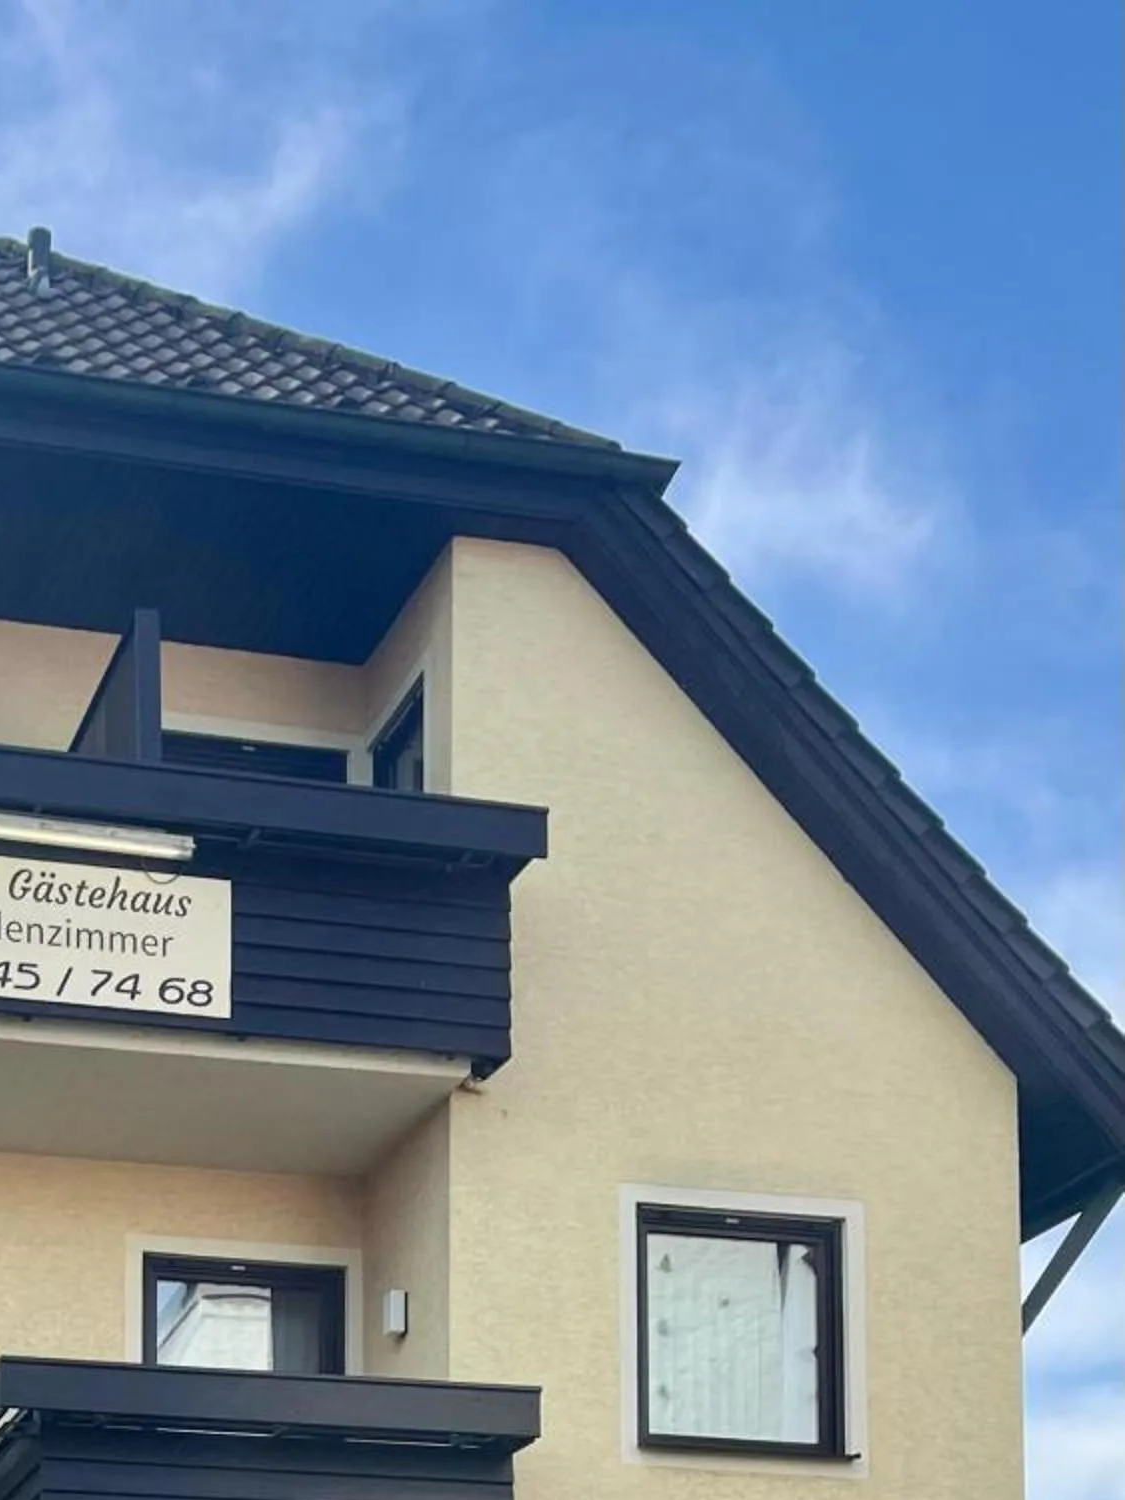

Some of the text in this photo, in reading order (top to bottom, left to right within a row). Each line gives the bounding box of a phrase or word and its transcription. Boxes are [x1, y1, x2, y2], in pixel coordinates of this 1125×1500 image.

[8, 868, 192, 917] Gästehaus
[56, 966, 74, 997] /
[89, 969, 142, 1000] 74
[158, 977, 214, 1007] 68
